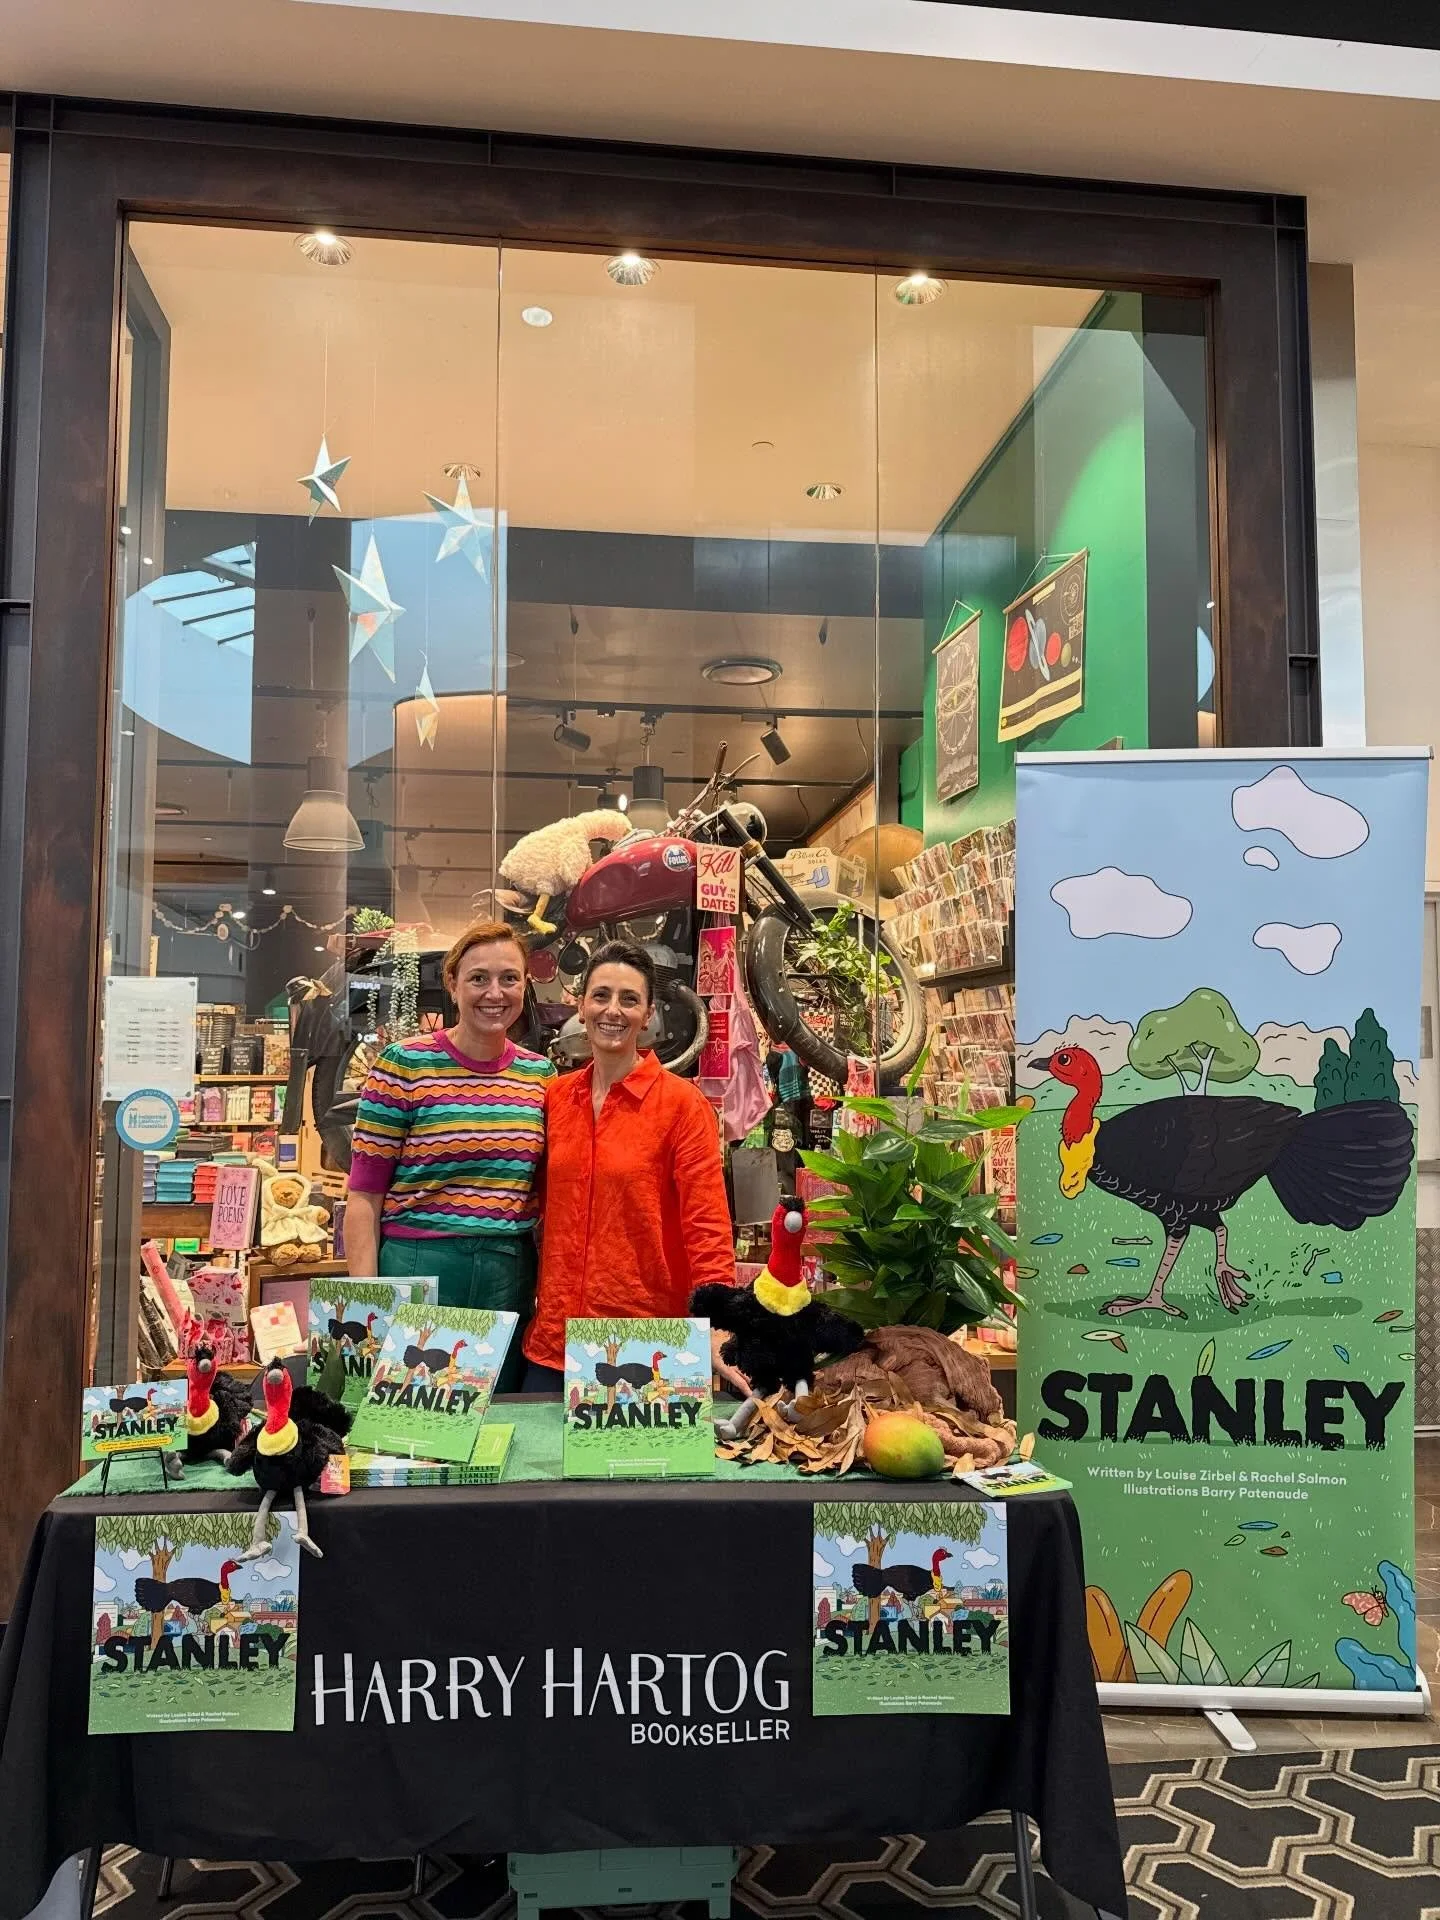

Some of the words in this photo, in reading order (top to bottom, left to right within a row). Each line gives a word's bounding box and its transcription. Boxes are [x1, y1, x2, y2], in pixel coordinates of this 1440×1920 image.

[697, 850, 736, 878] Kill
[701, 884, 727, 898] GUY
[701, 897, 736, 912] DATES
[219, 1184, 246, 1206] LOVE
[217, 1205, 244, 1223] POEMS
[369, 1380, 481, 1415] STANLEY
[1039, 1369, 1406, 1451] STANLEY
[94, 1416, 179, 1440] STANLEY
[573, 1402, 702, 1430] STANLEY
[1088, 1466, 1134, 1478] Written
[1136, 1467, 1153, 1481] by
[1155, 1469, 1196, 1481] Louise
[1199, 1469, 1236, 1482] Zirbel
[1239, 1471, 1248, 1482] &
[1251, 1471, 1295, 1484] Rachel
[1298, 1472, 1347, 1486] Salmon
[1123, 1483, 1198, 1497] Illustrations
[1201, 1486, 1235, 1501] Barry
[1239, 1487, 1309, 1500] Patenaude
[823, 1619, 1002, 1656] STANLEY
[101, 1632, 291, 1673] STANLEY
[311, 1652, 525, 1725] HARRY
[542, 1647, 790, 1718] HARTOG
[631, 1718, 790, 1747] BOOKSELLER
